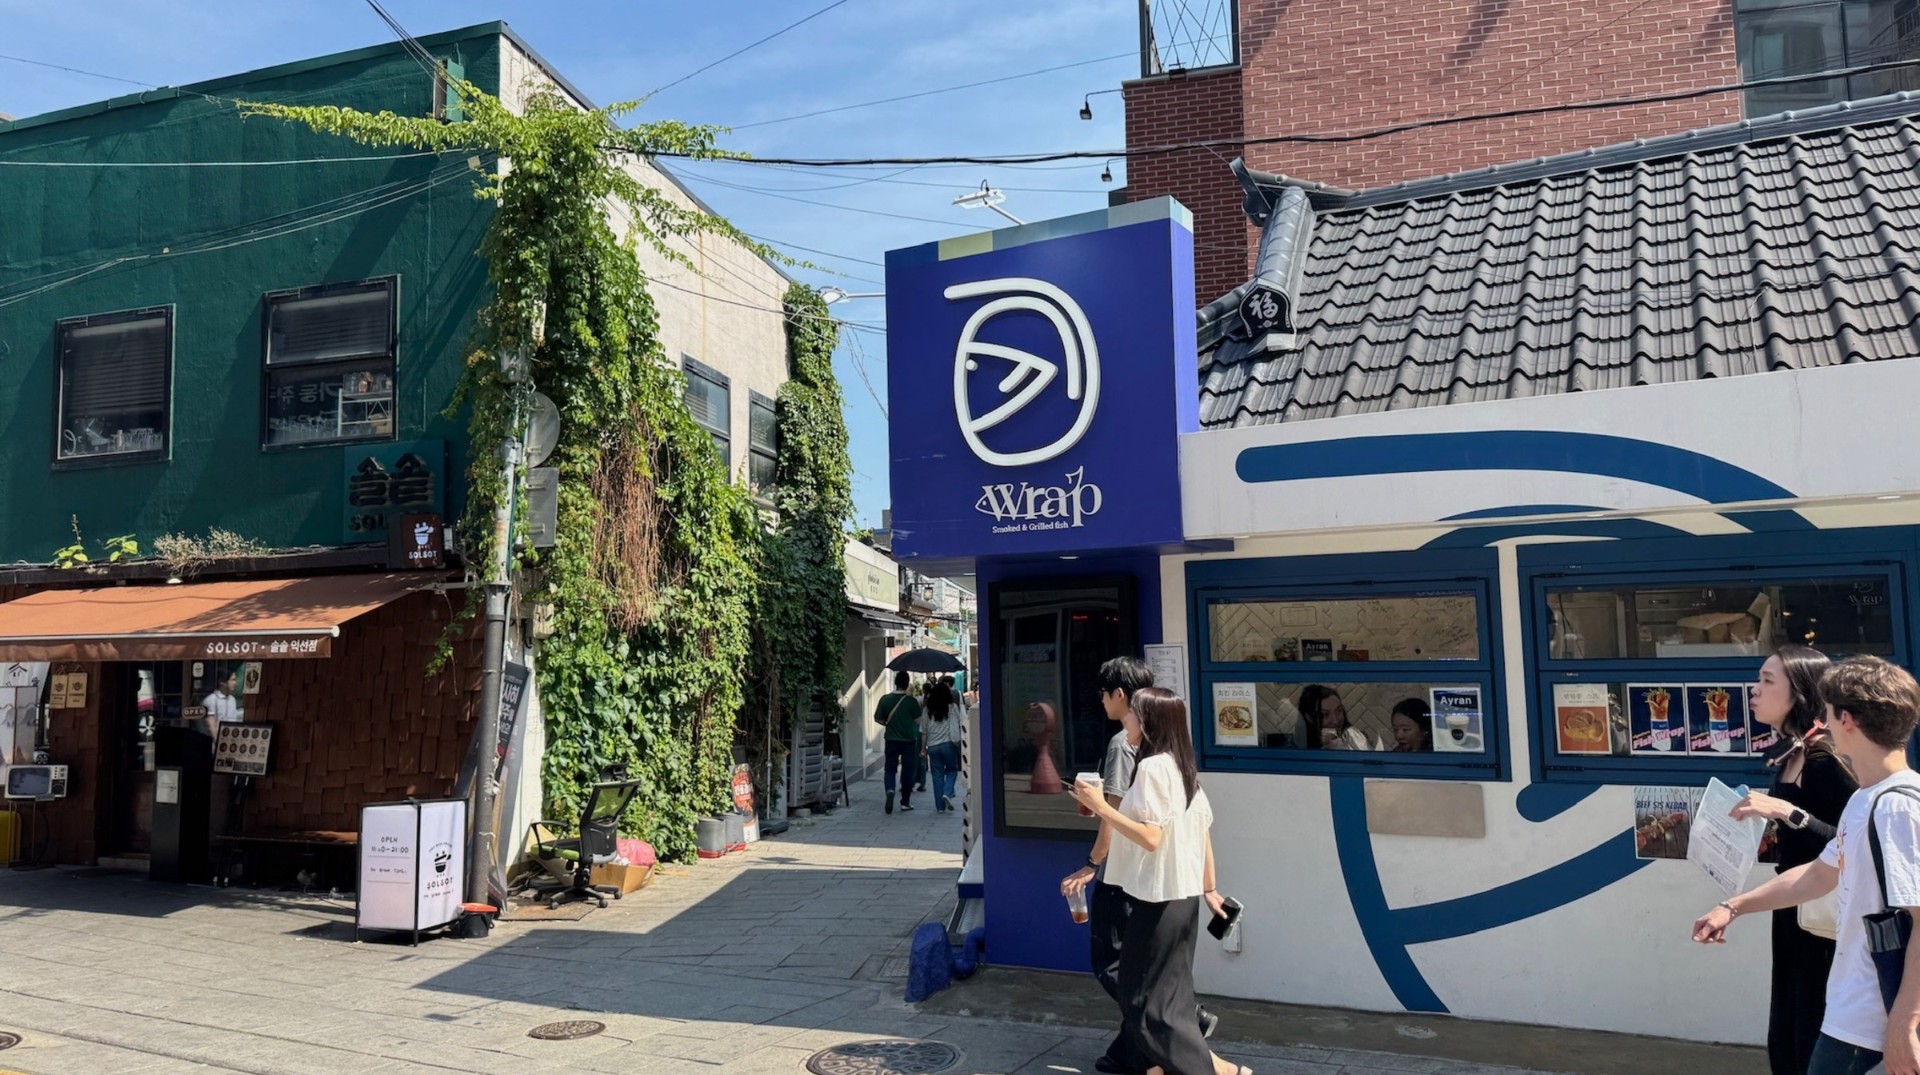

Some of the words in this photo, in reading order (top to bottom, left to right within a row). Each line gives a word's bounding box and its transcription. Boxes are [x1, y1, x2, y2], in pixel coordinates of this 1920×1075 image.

[1249, 291, 1279, 319] 福
[975, 465, 1103, 527] Wrap
[992, 524, 1021, 534] Smoked
[1029, 521, 1054, 531] Grilled
[1054, 520, 1069, 529] fish
[408, 549, 437, 560] SOLSOT
[206, 641, 258, 654] SOLSOT
[290, 639, 318, 653] 익선점
[1305, 643, 1329, 651] Ayran
[1440, 695, 1472, 706] Ayran
[184, 708, 205, 717] OPEN
[1657, 726, 1685, 741] Wrap
[1714, 726, 1745, 743] Wrap
[1636, 800, 1651, 810] BEEF
[1665, 801, 1688, 810] KEBAB
[426, 876, 454, 890] SOLSOT
